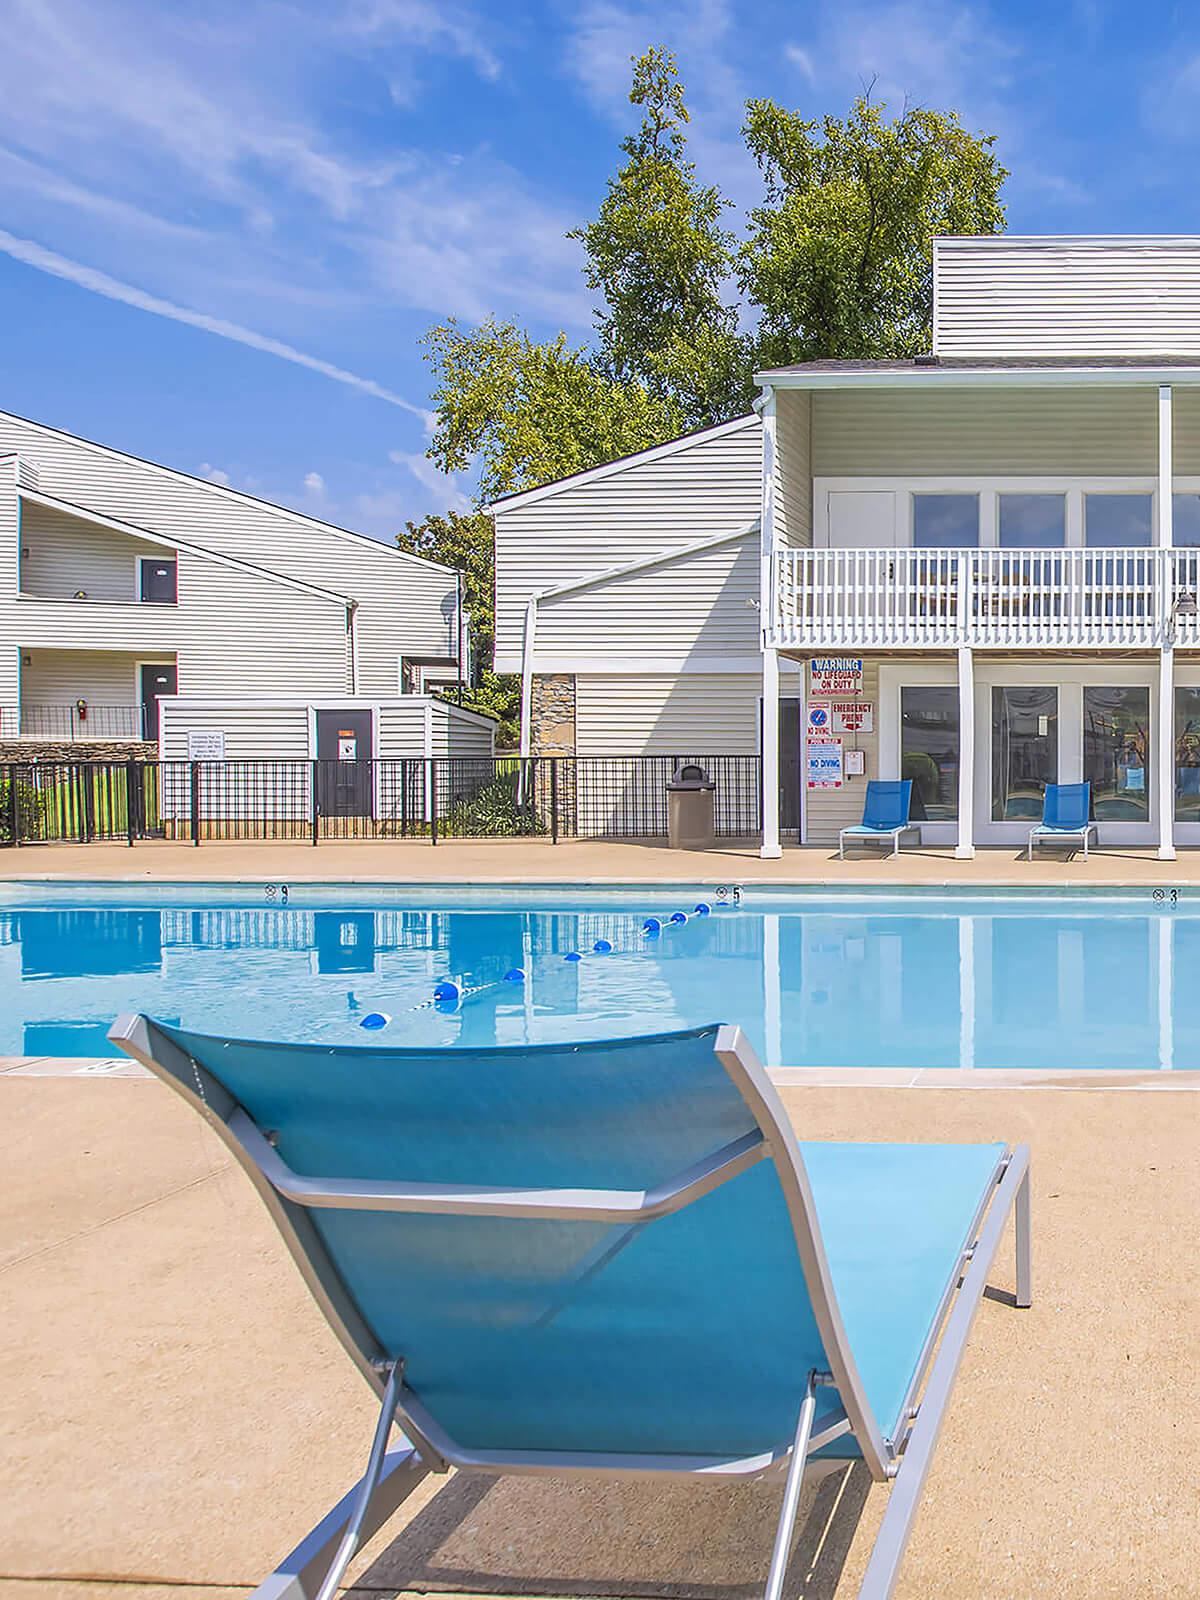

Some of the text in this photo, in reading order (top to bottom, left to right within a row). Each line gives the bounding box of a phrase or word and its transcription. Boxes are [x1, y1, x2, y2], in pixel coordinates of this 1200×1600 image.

[815, 659, 859, 671] WARNING
[811, 671, 861, 679] NO LIFEGUARD
[821, 680, 853, 689] ON DUTY
[833, 703, 871, 713] EMERGENCY
[841, 713, 863, 723] PHONE
[810, 759, 820, 768] NO
[821, 759, 841, 768] DIVING
